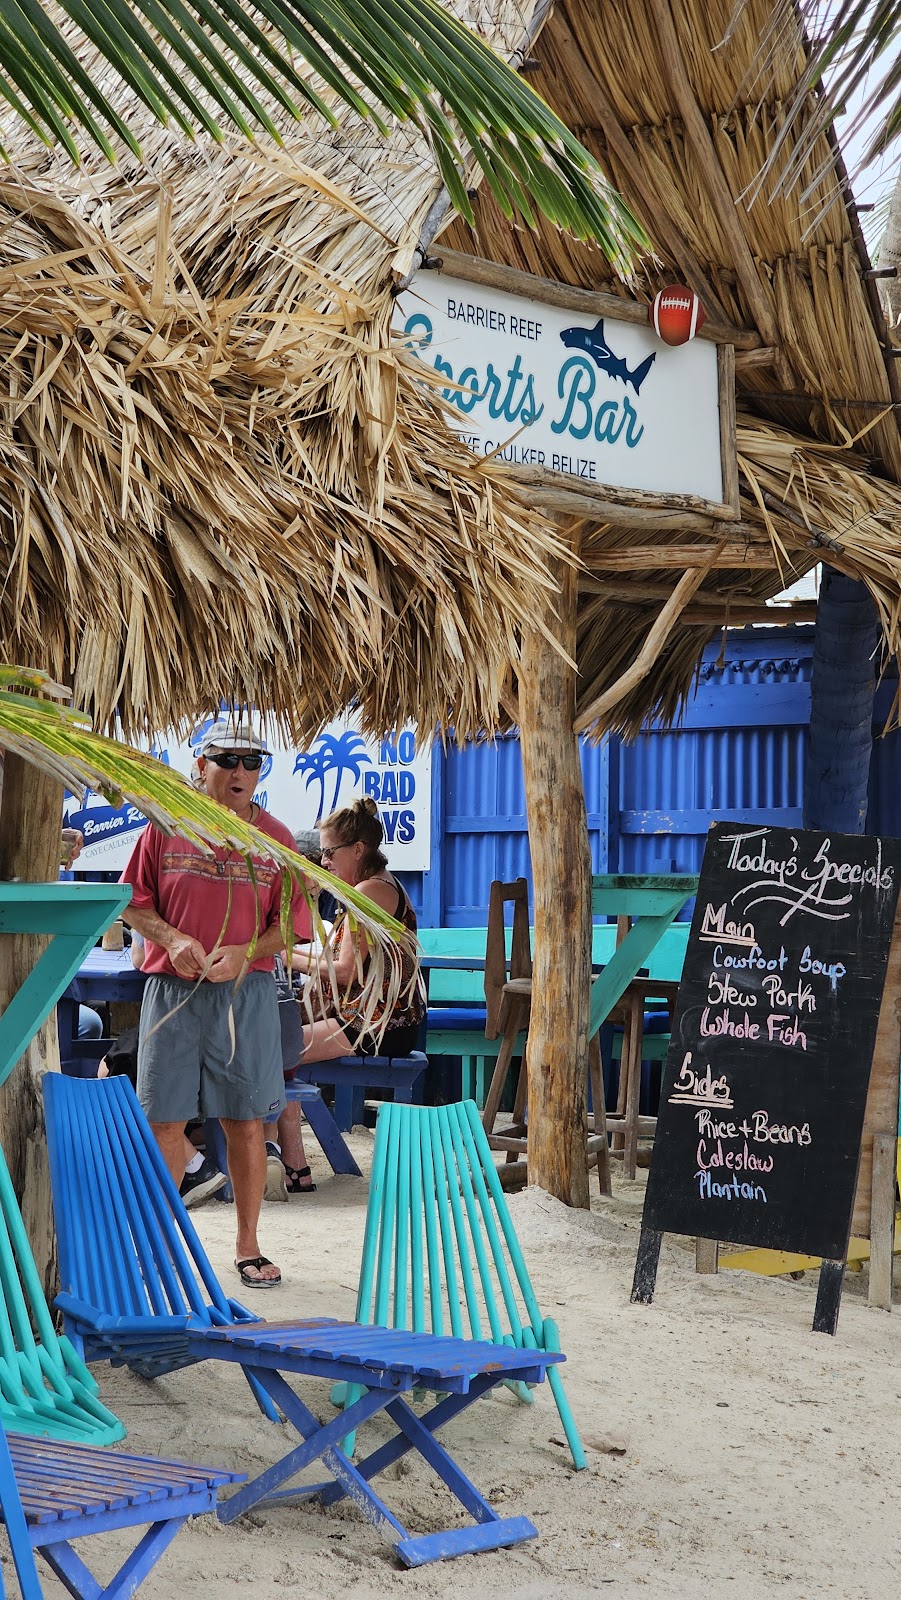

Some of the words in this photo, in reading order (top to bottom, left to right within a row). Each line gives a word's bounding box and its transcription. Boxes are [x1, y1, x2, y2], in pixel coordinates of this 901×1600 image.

[447, 298, 507, 333] BARRIER
[510, 316, 543, 342] REEF
[551, 355, 645, 449] Bar
[552, 453, 597, 480] BELIZE
[378, 731, 416, 766] NO
[362, 770, 416, 805] BAD
[83, 819, 125, 837] Barrier
[375, 810, 416, 844] YS
[85, 845, 104, 859] CAYE
[719, 827, 799, 886] Today's
[801, 837, 895, 905] Specials
[701, 902, 756, 940] Main
[713, 945, 789, 970] Cowfoot
[799, 945, 847, 990] Soup
[707, 971, 758, 1007] Stew
[762, 974, 817, 1012] Pork
[700, 1007, 760, 1040] Whole
[766, 1013, 807, 1050] Fish
[673, 1051, 731, 1099] Sides
[696, 1138, 774, 1173] Coleslaw
[693, 1170, 768, 1203] Plantain
